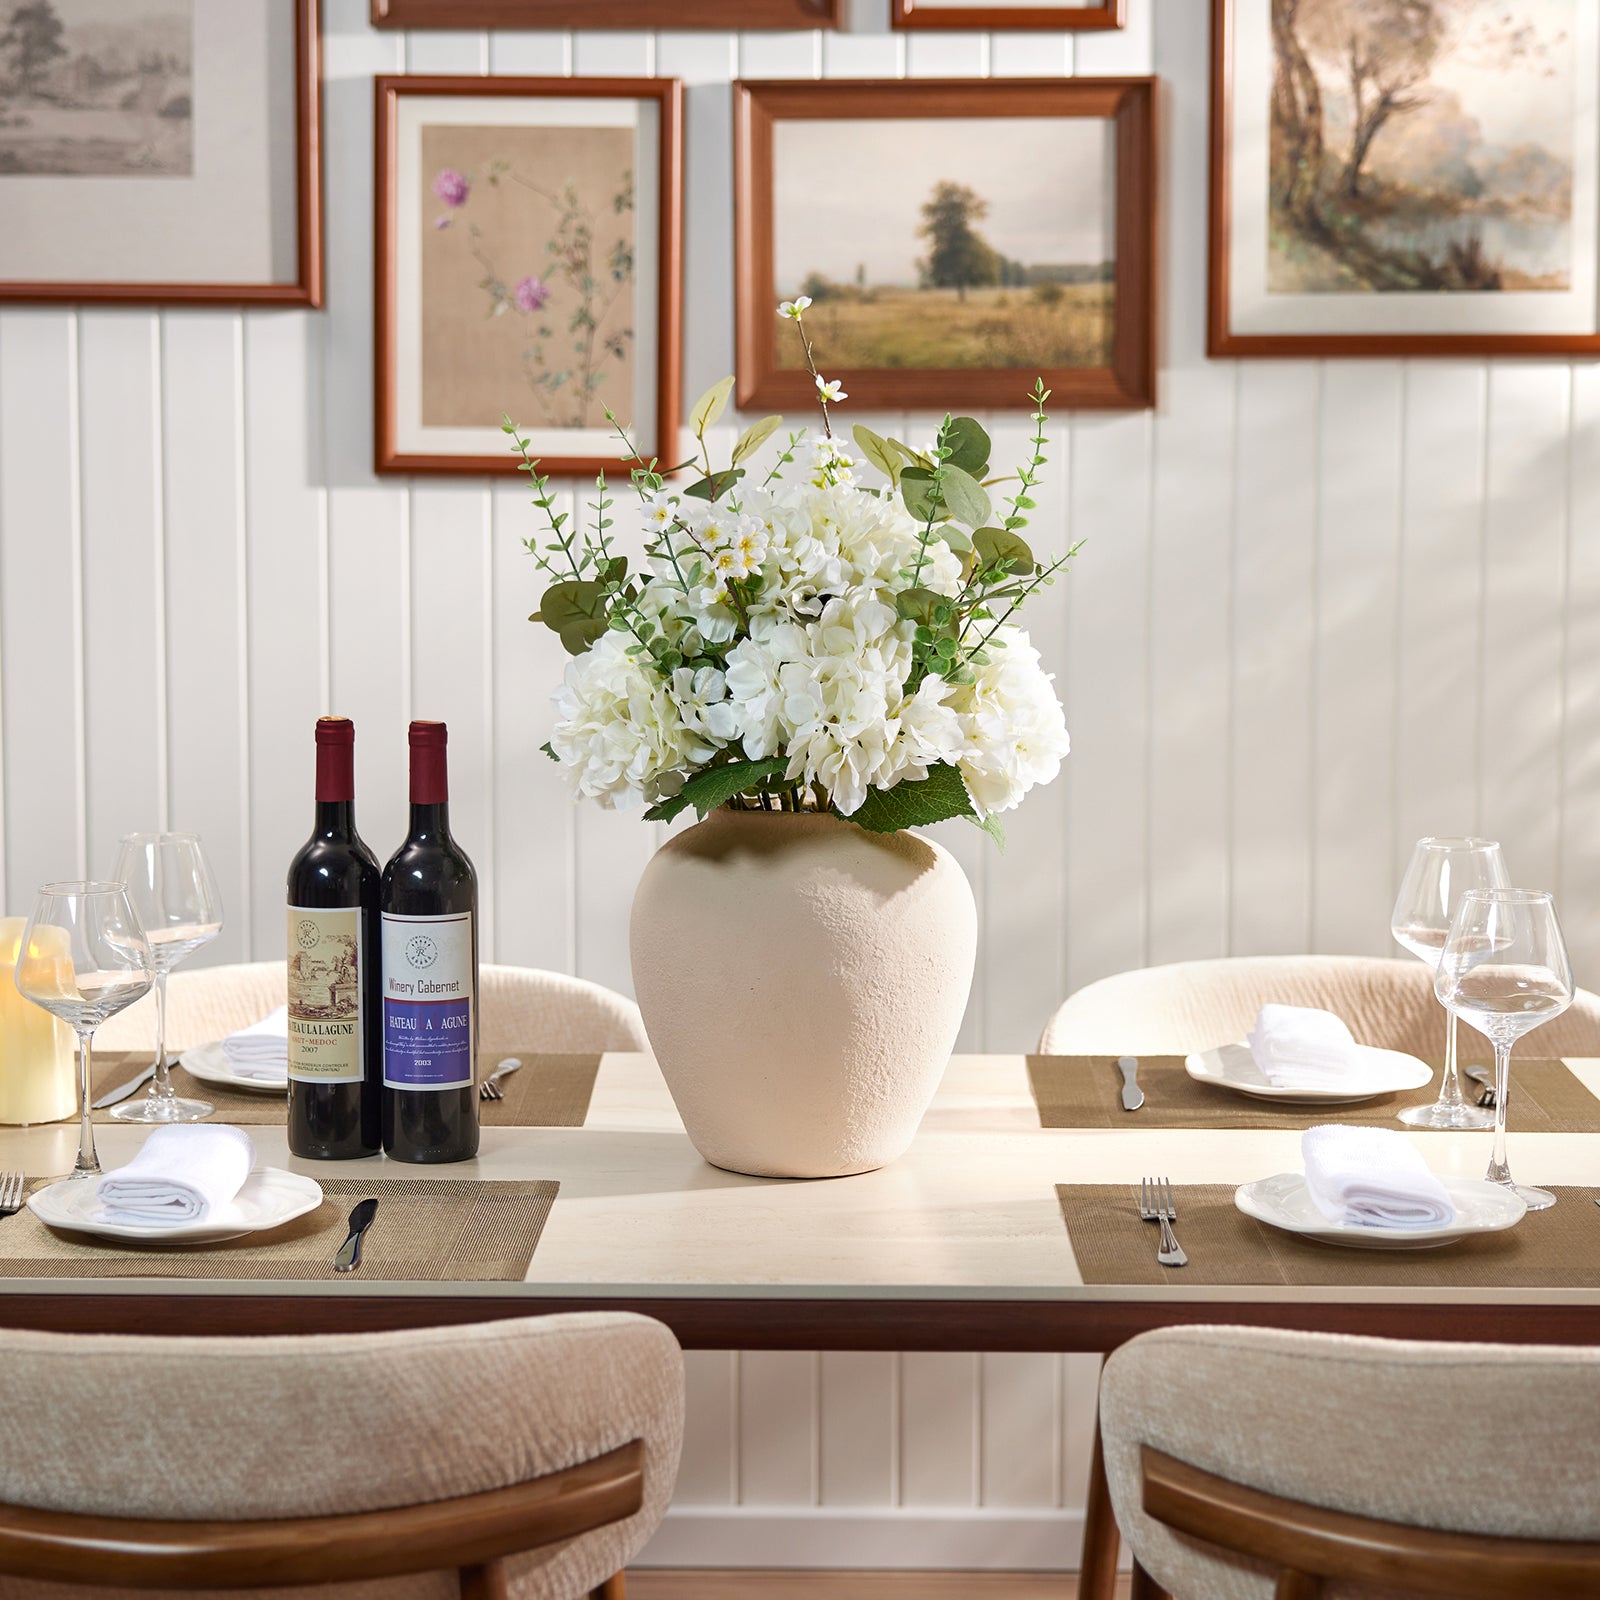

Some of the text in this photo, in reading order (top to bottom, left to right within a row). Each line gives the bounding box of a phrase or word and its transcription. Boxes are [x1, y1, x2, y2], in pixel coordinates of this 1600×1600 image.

[388, 977, 460, 996] Winery Cabernet
[301, 1046, 319, 1054] 2007
